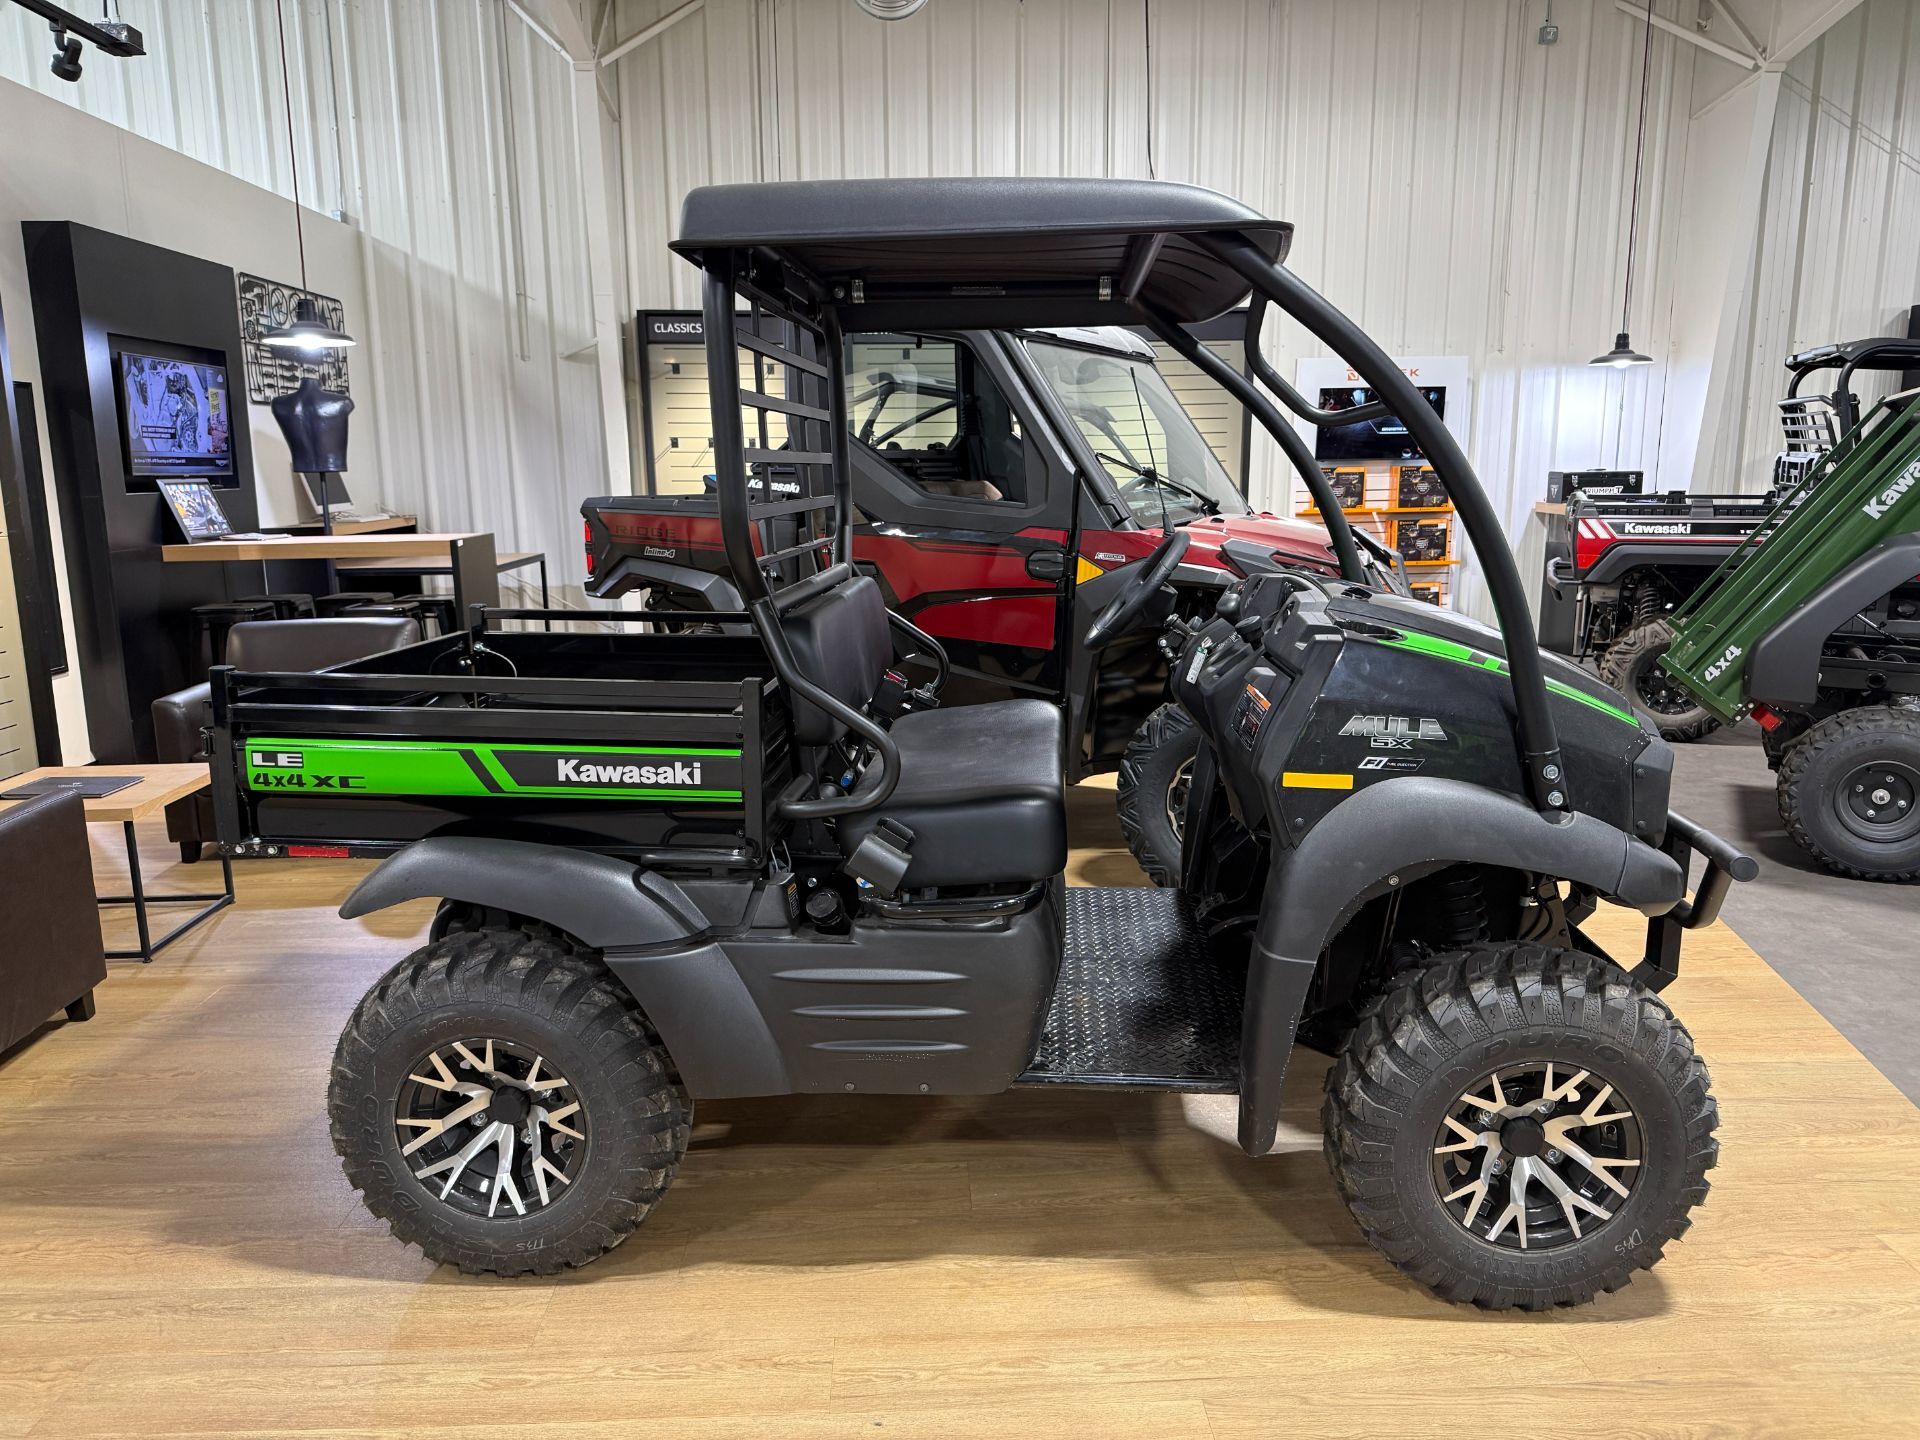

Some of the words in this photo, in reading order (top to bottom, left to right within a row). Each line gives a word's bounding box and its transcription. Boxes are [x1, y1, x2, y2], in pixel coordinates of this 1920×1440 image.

[654, 323, 703, 333] CLASSICS
[747, 478, 800, 493] Kaasaki
[615, 525, 677, 538] RIDGE
[1624, 522, 1691, 534] Kawasaki
[1704, 645, 1742, 682] 4x4
[1338, 715, 1448, 740] MULE
[1371, 737, 1414, 750] SX
[252, 752, 303, 766] LE
[557, 758, 701, 785] Kawasaki
[253, 772, 306, 787] 4x4
[310, 774, 367, 788] XC
[1482, 1031, 1628, 1064] DURO
